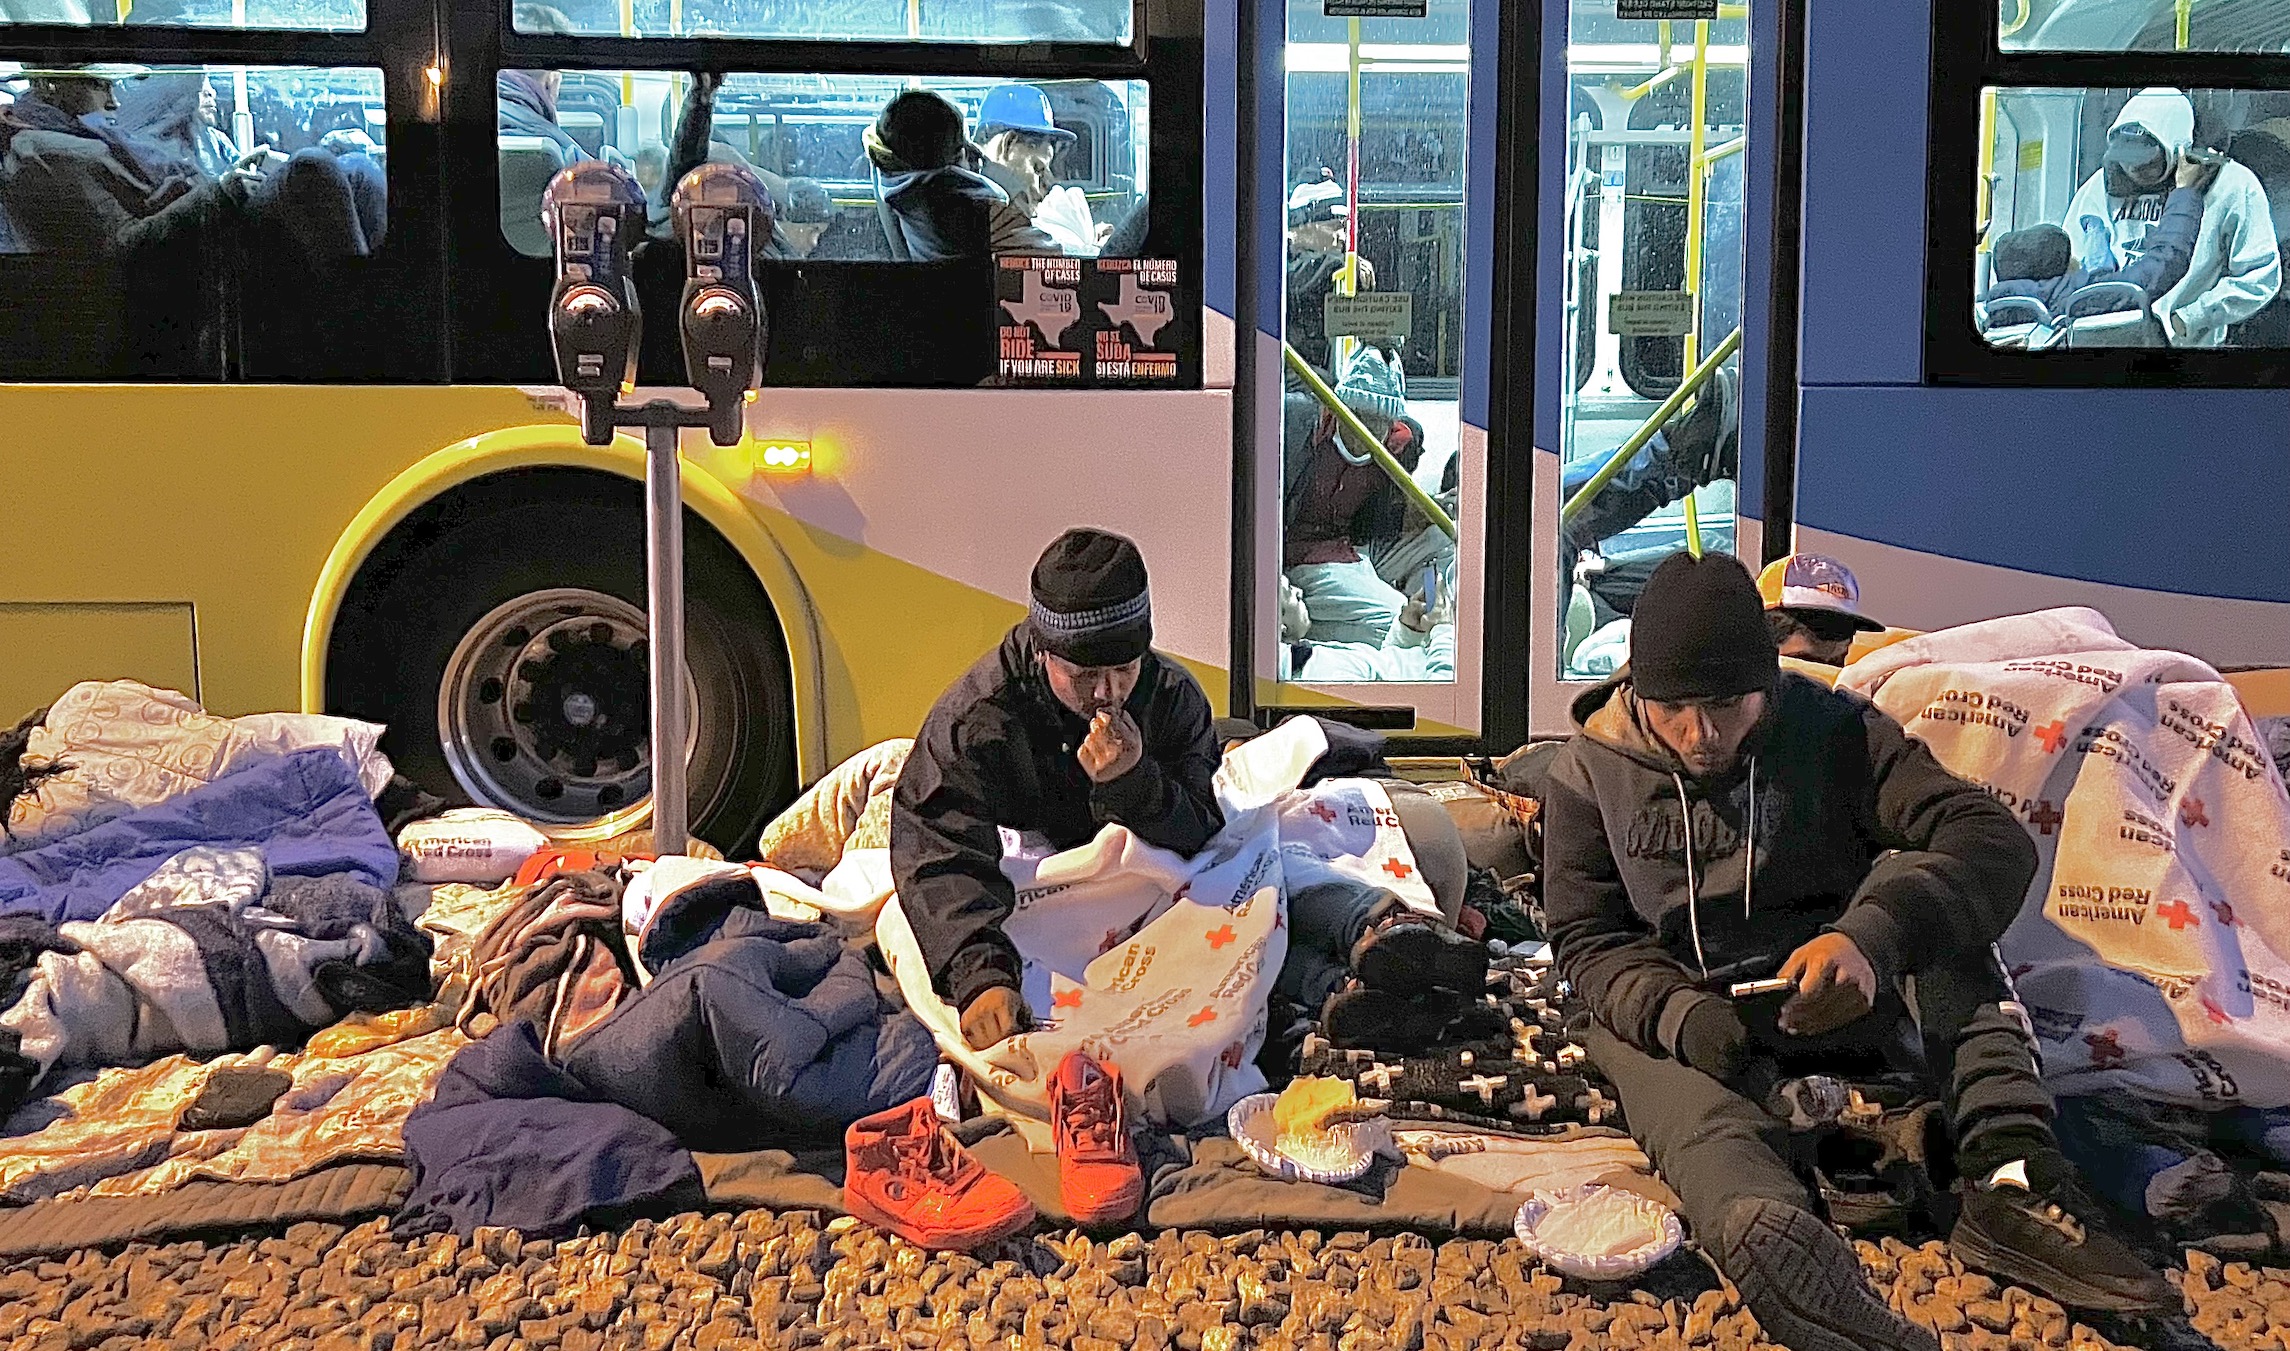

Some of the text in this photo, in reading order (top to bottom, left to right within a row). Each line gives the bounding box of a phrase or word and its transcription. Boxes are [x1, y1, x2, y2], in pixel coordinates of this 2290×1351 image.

[1031, 258, 1046, 270] THE
[1133, 259, 1141, 270] EL
[1045, 270, 1080, 283] OF CASES
[1140, 271, 1176, 284] DE CASOS
[1000, 326, 1012, 338] DO
[1000, 339, 1034, 358] RIDE
[1000, 360, 1080, 377] IF YOU ARE SICK
[1096, 362, 1105, 377] SI
[1132, 362, 1177, 377] ENFERMO
[1936, 689, 2030, 724] Red Cro
[1921, 706, 2023, 738] American
[2120, 825, 2172, 851] ican
[2059, 885, 2151, 905] Red Cross
[2059, 904, 2147, 926] American
